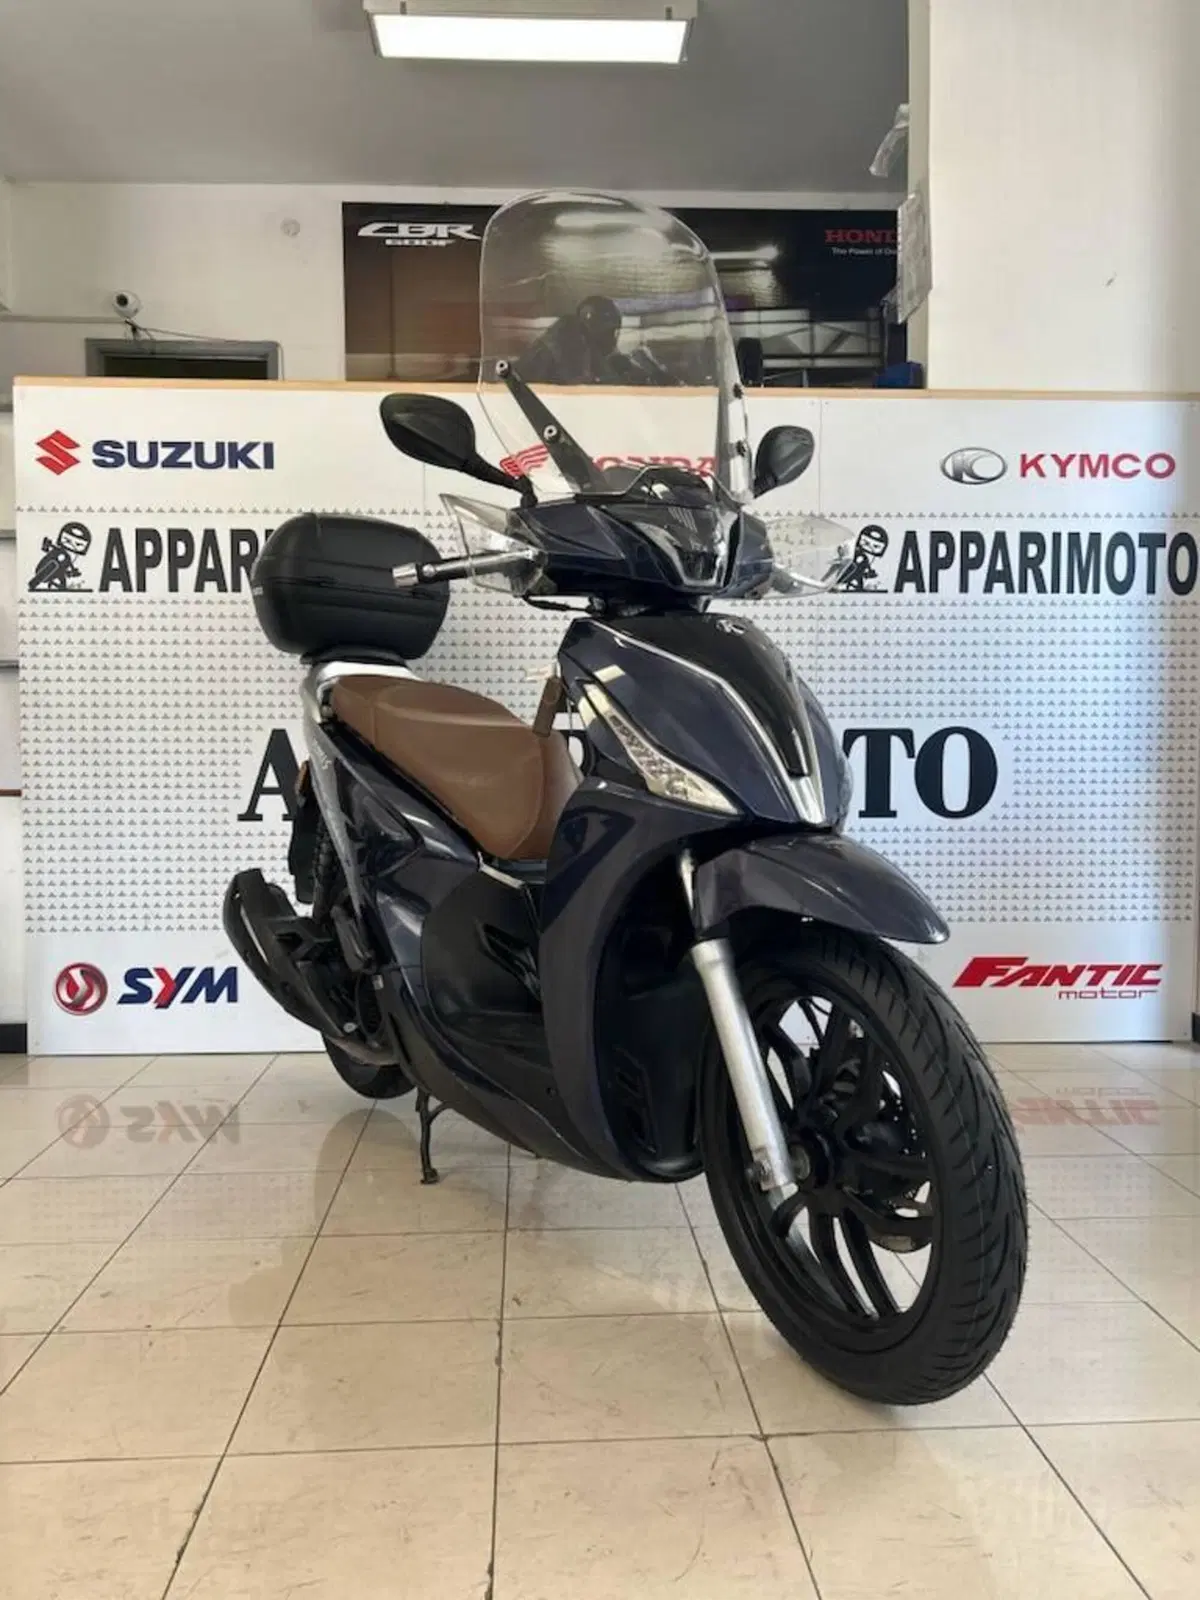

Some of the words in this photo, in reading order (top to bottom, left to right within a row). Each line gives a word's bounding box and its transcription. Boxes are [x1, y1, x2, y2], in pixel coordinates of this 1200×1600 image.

[358, 222, 481, 240] CBR
[825, 229, 897, 243] HOND
[92, 440, 274, 470] SUZUKI
[1019, 452, 1176, 479] KYMCO
[100, 527, 273, 593] APPAR
[893, 530, 1199, 596] APPARIMOTO
[117, 966, 238, 1009] SYM
[952, 957, 1162, 988] FANTIC
[1058, 988, 1158, 1000] motor
